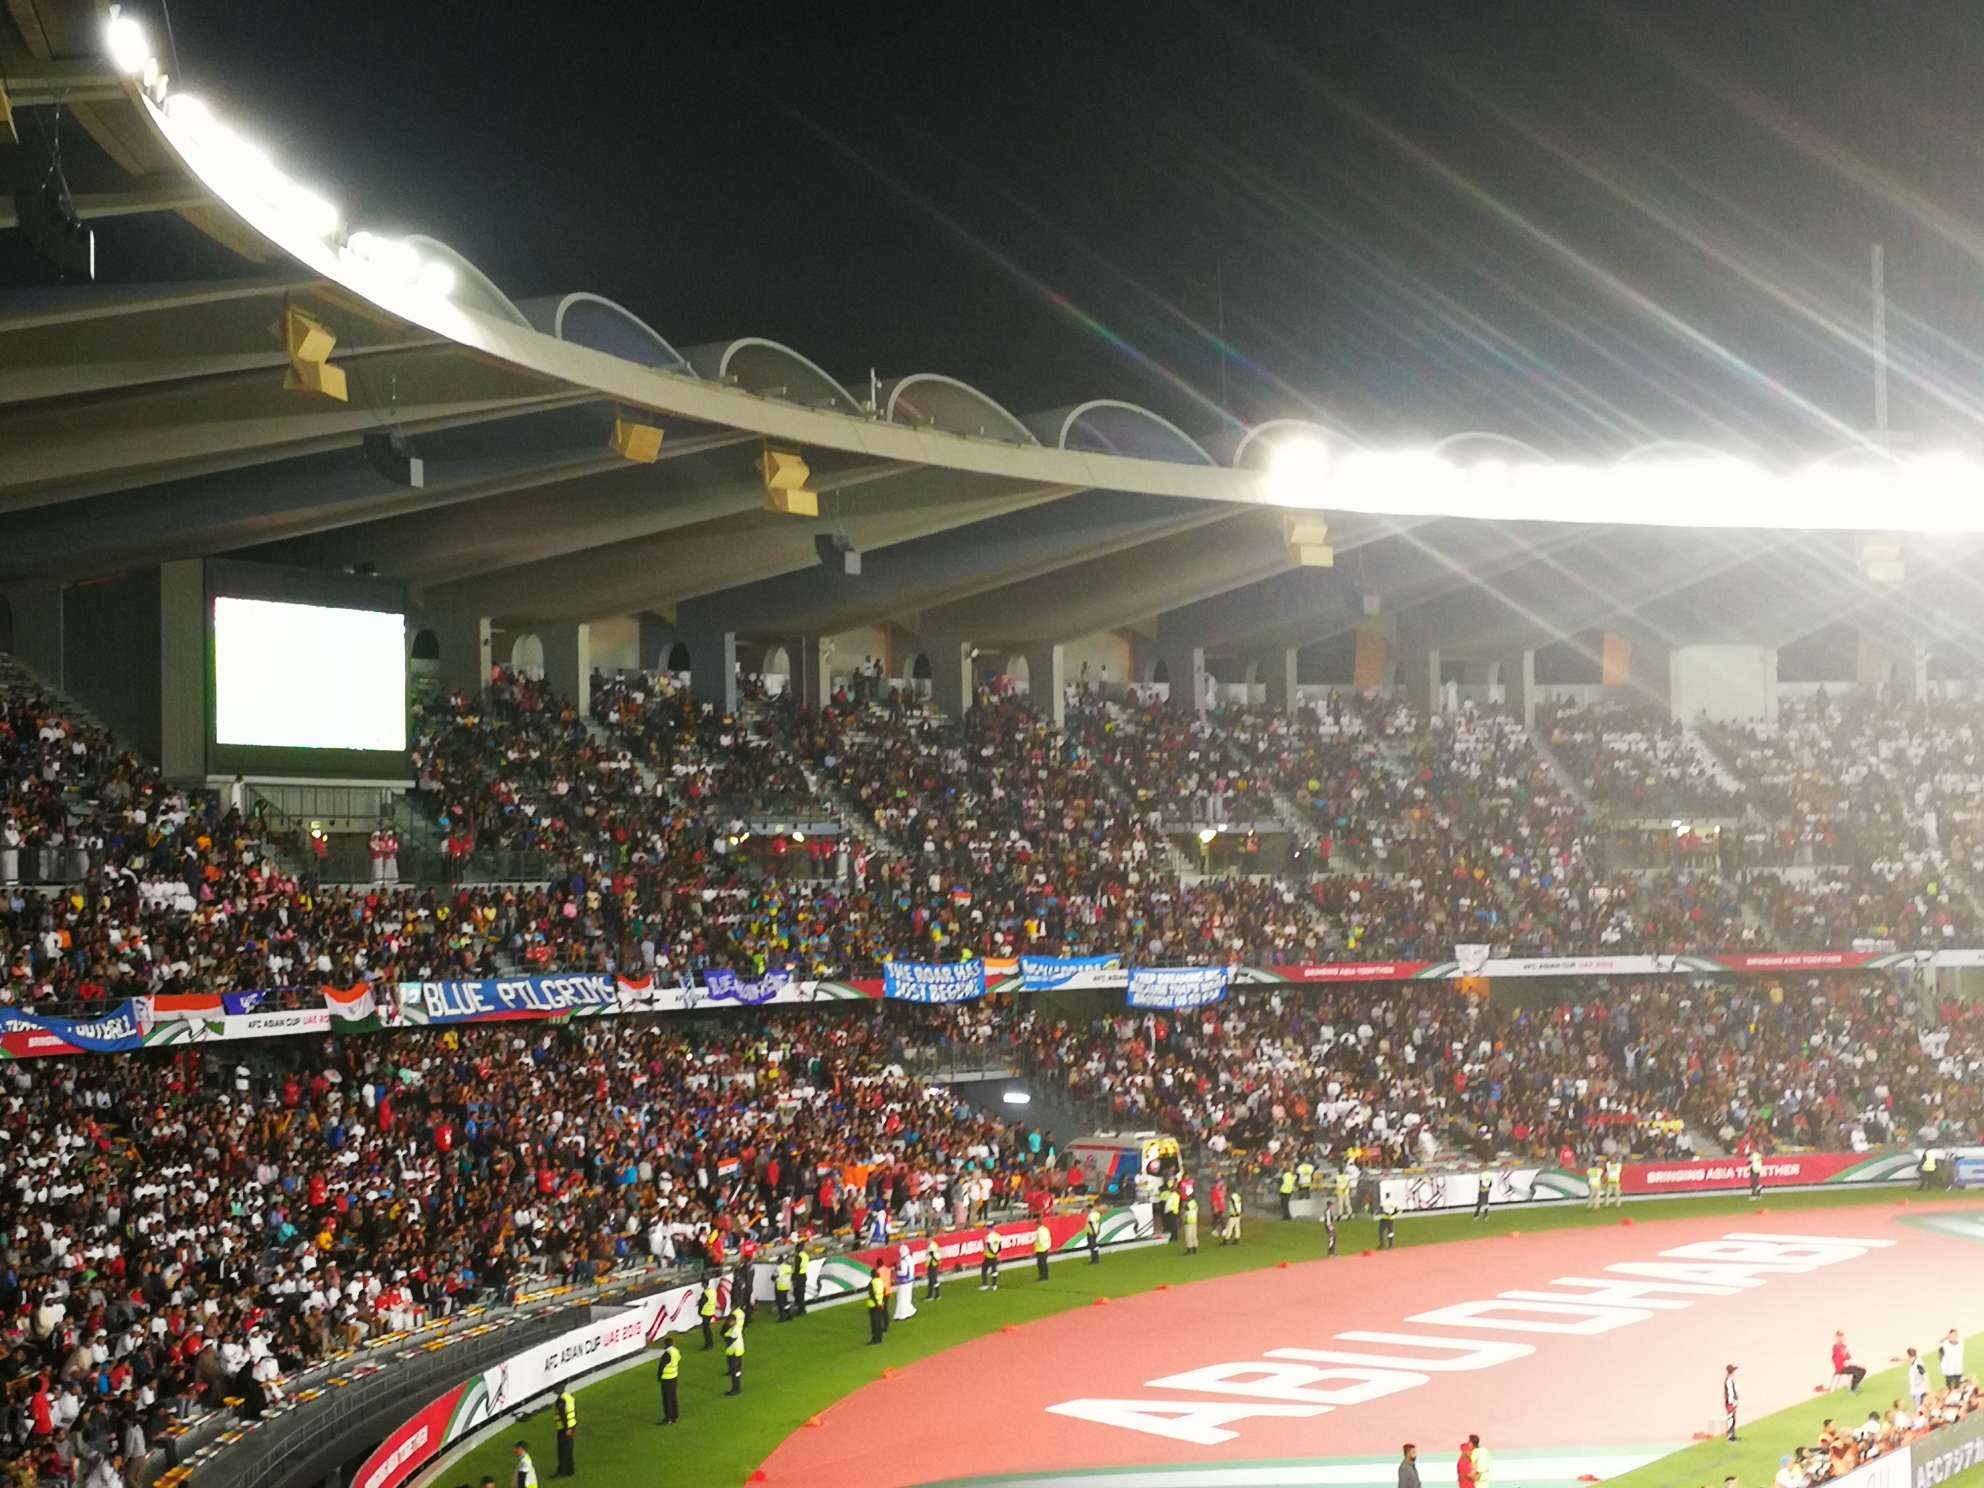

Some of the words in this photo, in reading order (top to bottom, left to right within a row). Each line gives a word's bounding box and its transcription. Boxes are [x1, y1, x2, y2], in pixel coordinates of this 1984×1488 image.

[423, 982, 495, 1017] BLUE
[496, 976, 618, 1011] PILGRIMS
[248, 1020, 262, 1029] AFC
[264, 1018, 285, 1028] ASIAN
[286, 1017, 301, 1027] CUP
[1647, 1168, 1706, 1184] BRINGING
[1706, 1165, 1735, 1181] ASIA
[544, 1353, 558, 1371] AFC
[561, 1343, 583, 1363] ASIAN
[585, 1335, 601, 1354] CUP
[1045, 1331, 1536, 1445] ABU
[1403, 1232, 1899, 1336] DHABI
